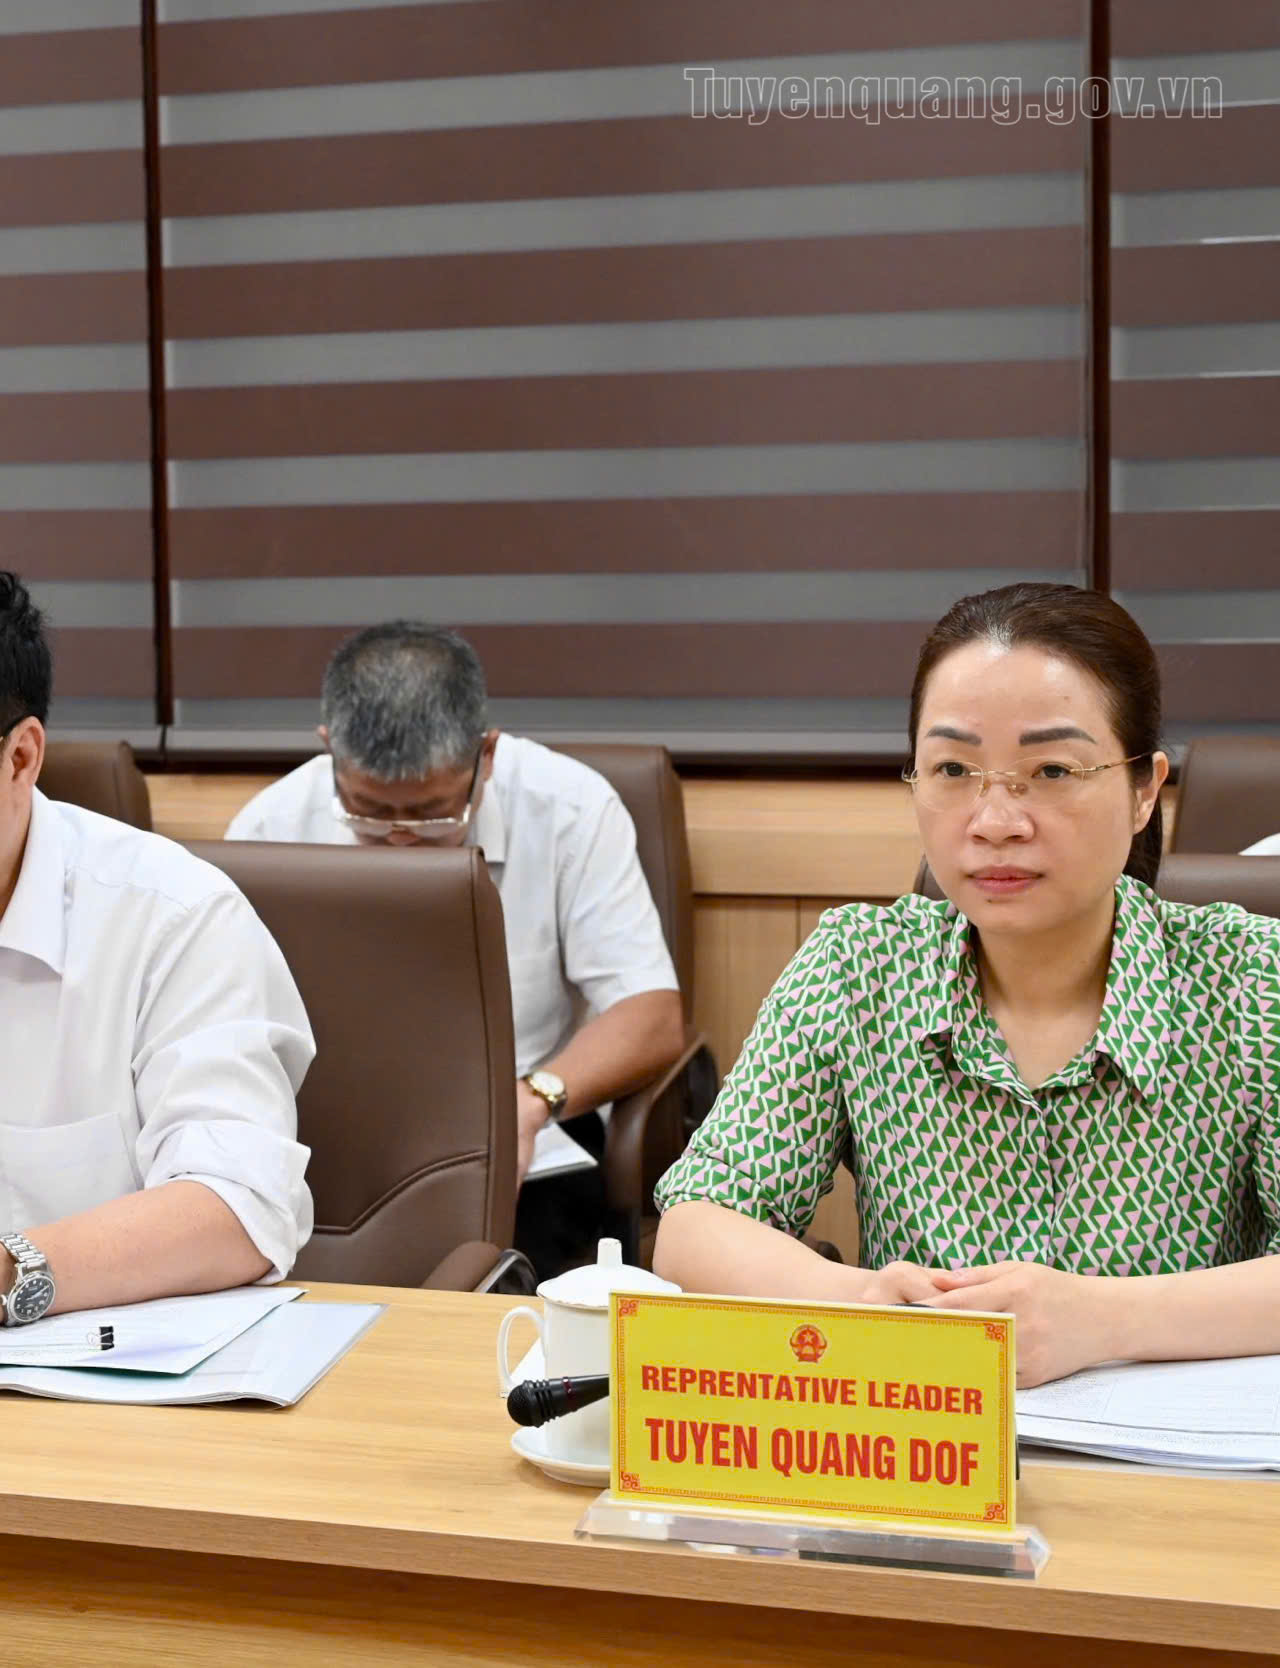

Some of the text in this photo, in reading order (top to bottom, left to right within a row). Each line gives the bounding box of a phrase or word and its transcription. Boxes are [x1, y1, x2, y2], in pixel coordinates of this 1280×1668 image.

[641, 1365, 983, 1415] REPRENTATIVE LEADER
[645, 1417, 980, 1487] TUYEN QUANG DOF
